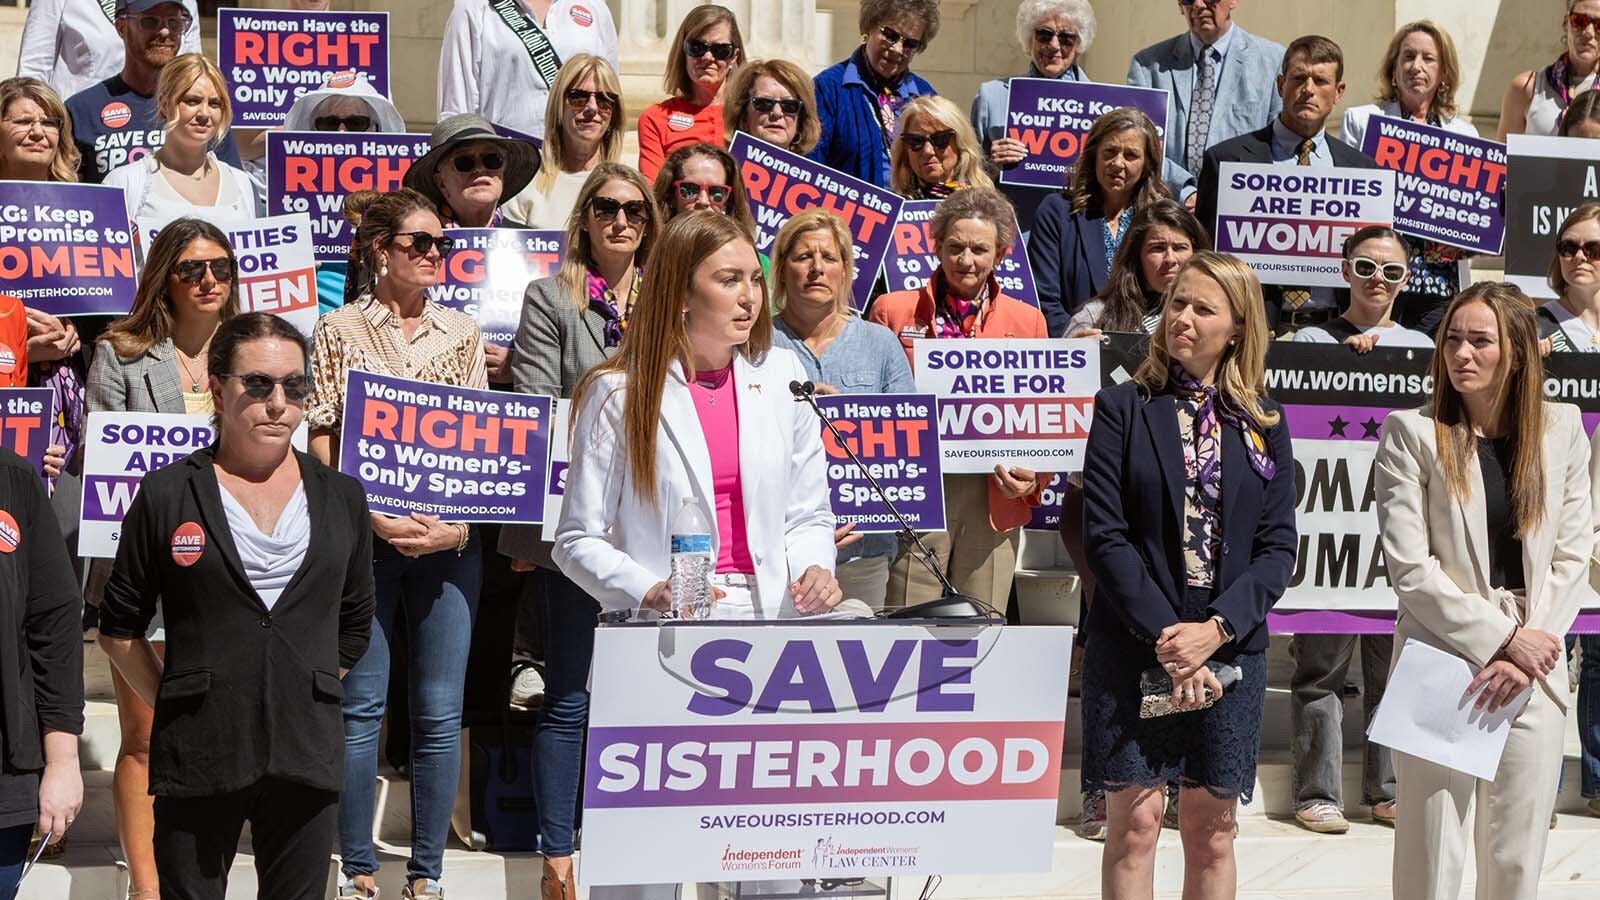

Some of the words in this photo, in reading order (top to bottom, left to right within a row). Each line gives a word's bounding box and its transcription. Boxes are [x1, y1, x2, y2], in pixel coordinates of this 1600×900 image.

[233, 17, 299, 32] Women
[303, 19, 347, 33] Have
[350, 19, 380, 33] the
[235, 31, 380, 67] RIGHT
[231, 66, 257, 83] to
[235, 85, 289, 107] Only
[1037, 97, 1084, 114] KKG:
[1010, 111, 1055, 128] Your
[95, 130, 144, 153] SAVE
[283, 140, 357, 155] Women
[362, 141, 409, 156] Have
[1381, 122, 1440, 147] Women
[1443, 137, 1483, 158] Have
[285, 156, 418, 193] RIGH
[1375, 135, 1508, 194] RIGHT
[746, 144, 812, 182] Women
[814, 172, 859, 201] Have
[862, 191, 892, 214] the
[1231, 172, 1383, 197] SORORITIES
[740, 159, 888, 245] RIGHT
[1397, 172, 1498, 210] Women's-
[282, 194, 310, 212] to
[1249, 196, 1302, 215] ARE
[1311, 199, 1361, 218] FOR
[1419, 197, 1492, 228] Spaces
[33, 204, 95, 228] Keep
[1532, 205, 1551, 235] IS
[0, 222, 99, 244] Promise
[103, 227, 130, 244] to
[1226, 220, 1361, 254] WOME
[526, 237, 560, 252] the
[0, 245, 134, 280] OMEN
[240, 252, 279, 274] OR
[896, 257, 921, 273] to
[927, 350, 1087, 370] SORORITIES
[950, 374, 1005, 394] ARE
[1013, 374, 1066, 394] FOR
[7, 398, 43, 415] the
[364, 381, 442, 408] Women
[447, 395, 500, 415] Have
[505, 402, 540, 418] the
[844, 403, 892, 418] Have
[896, 402, 929, 418] the
[362, 398, 539, 456] RIGHT
[939, 402, 1094, 436] WOMEN
[822, 419, 929, 459] GHT
[358, 438, 386, 460] to
[394, 443, 531, 476] Women's-
[944, 448, 1074, 459] SAVEOURSISTERHOOD.COM
[359, 461, 422, 493] Only
[428, 472, 527, 498] Spaces
[366, 493, 516, 515] SAVEOURSISTERHOOD.COM
[838, 483, 926, 507] Spaces
[0, 521, 19, 539] AVE
[174, 535, 201, 546] SAVE
[686, 638, 979, 717] SAVE
[597, 737, 1050, 793] SISTERHOOD
[700, 810, 945, 829] SAVEOURSISTERHOOD.COM
[768, 860, 801, 870] Forum
[829, 857, 859, 868] LAW
[861, 856, 917, 868] CENTER
